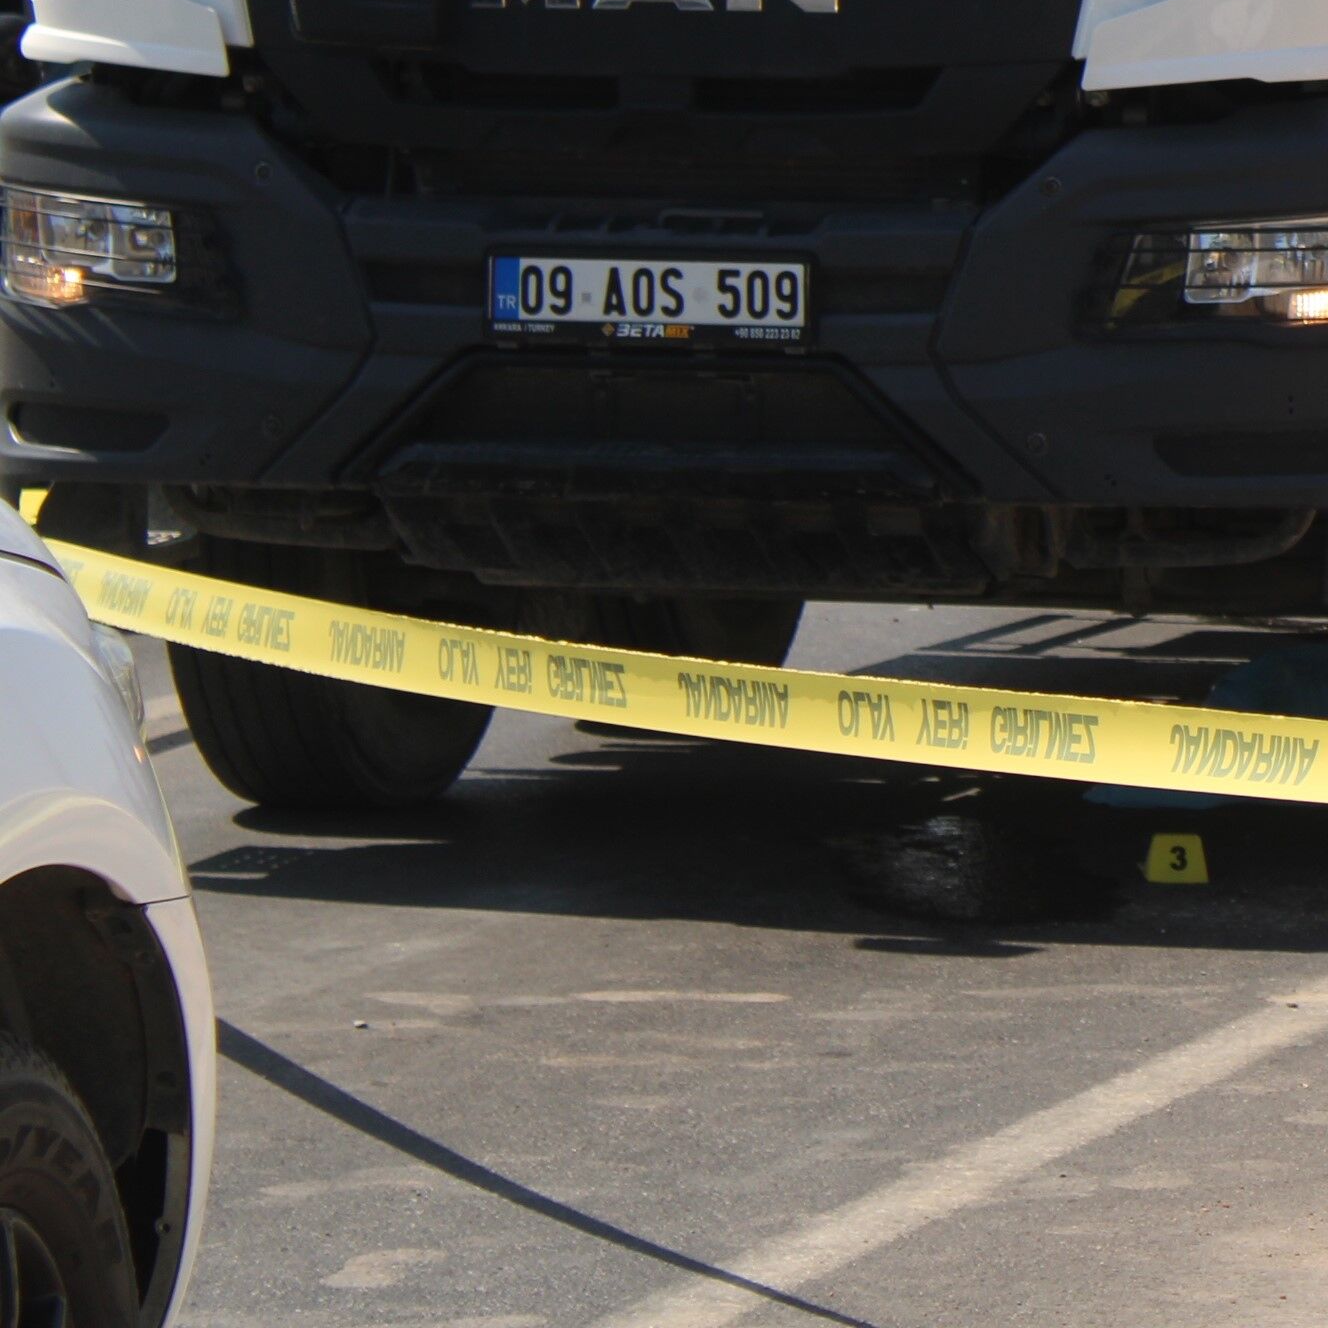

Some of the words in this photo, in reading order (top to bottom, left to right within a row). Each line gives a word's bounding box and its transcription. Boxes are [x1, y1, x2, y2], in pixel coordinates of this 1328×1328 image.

[498, 294, 516, 310] TR
[520, 265, 573, 316] 09
[603, 267, 685, 317] AOS
[717, 269, 799, 320] 509
[1169, 845, 1188, 872] 3
